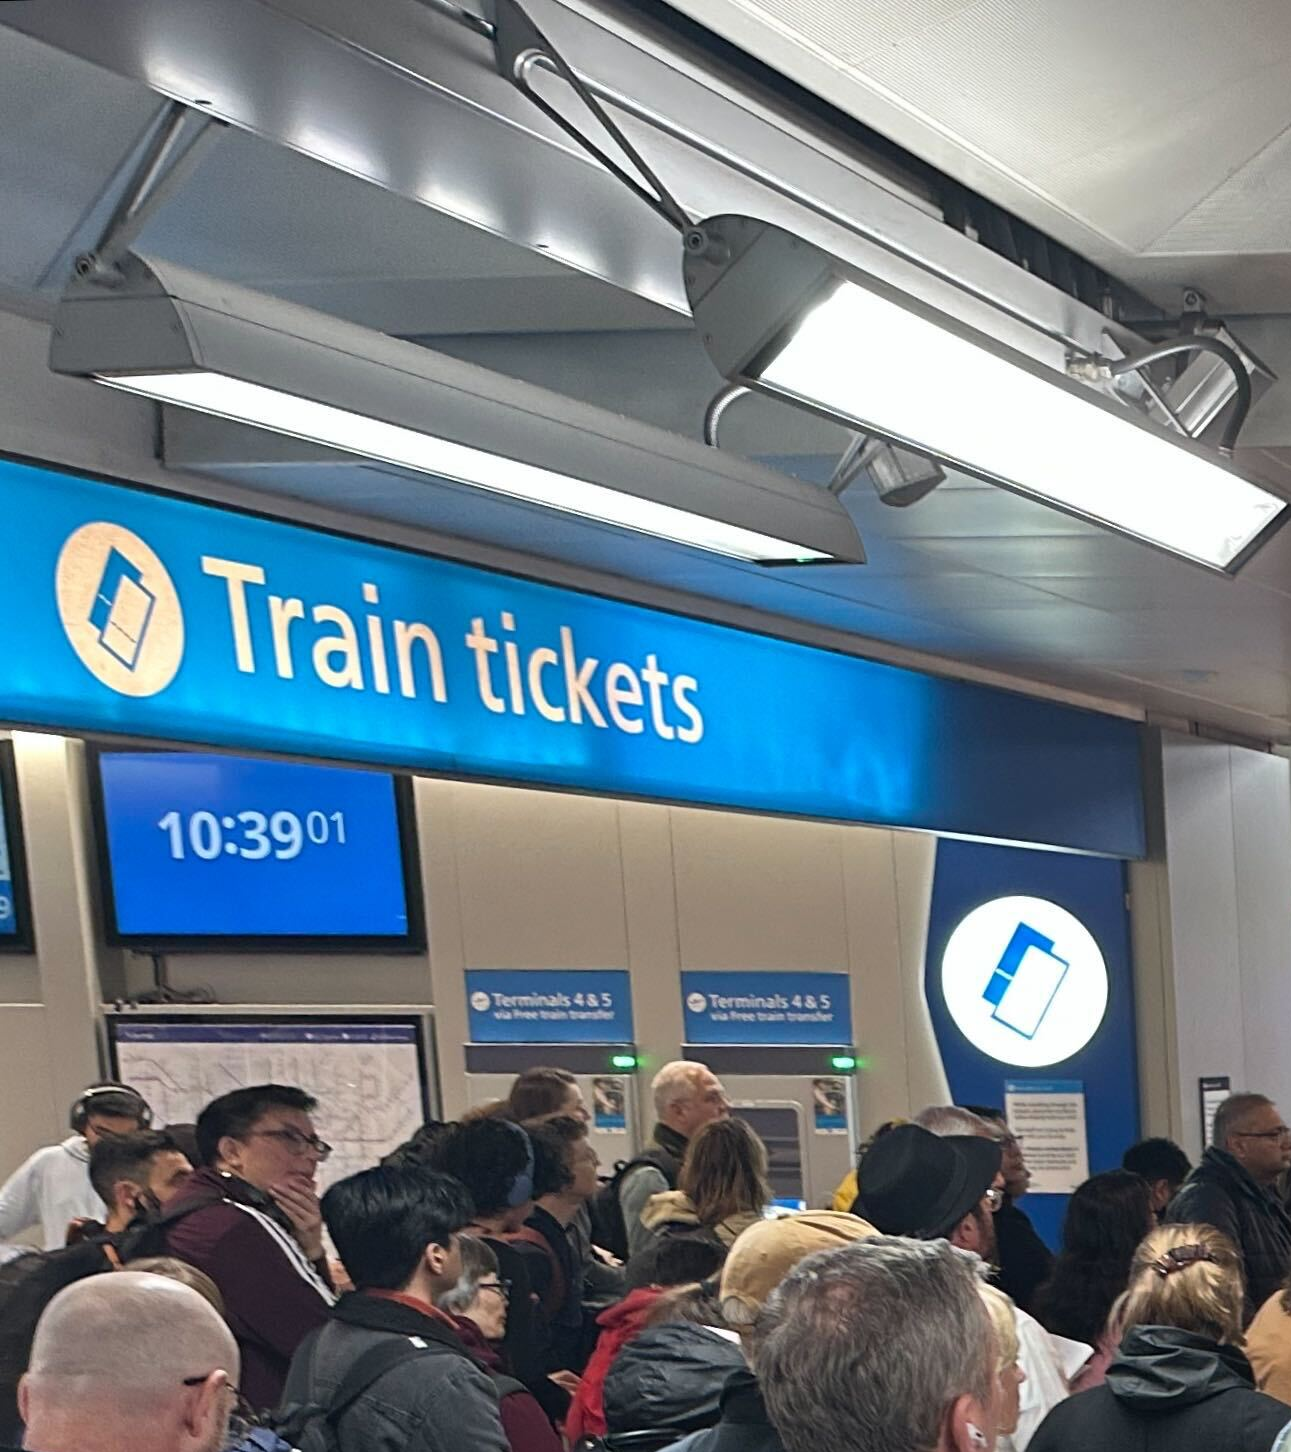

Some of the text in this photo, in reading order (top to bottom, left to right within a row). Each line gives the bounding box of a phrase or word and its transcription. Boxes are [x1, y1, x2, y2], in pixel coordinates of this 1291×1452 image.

[202, 556, 704, 744] Train tickets
[157, 810, 346, 860] 10:39 01
[491, 992, 612, 1008] Terminals 4 & 5
[708, 993, 831, 1009] Terminals 4 & 5
[568, 1009, 615, 1020] transfer
[786, 1011, 834, 1021] transfer
